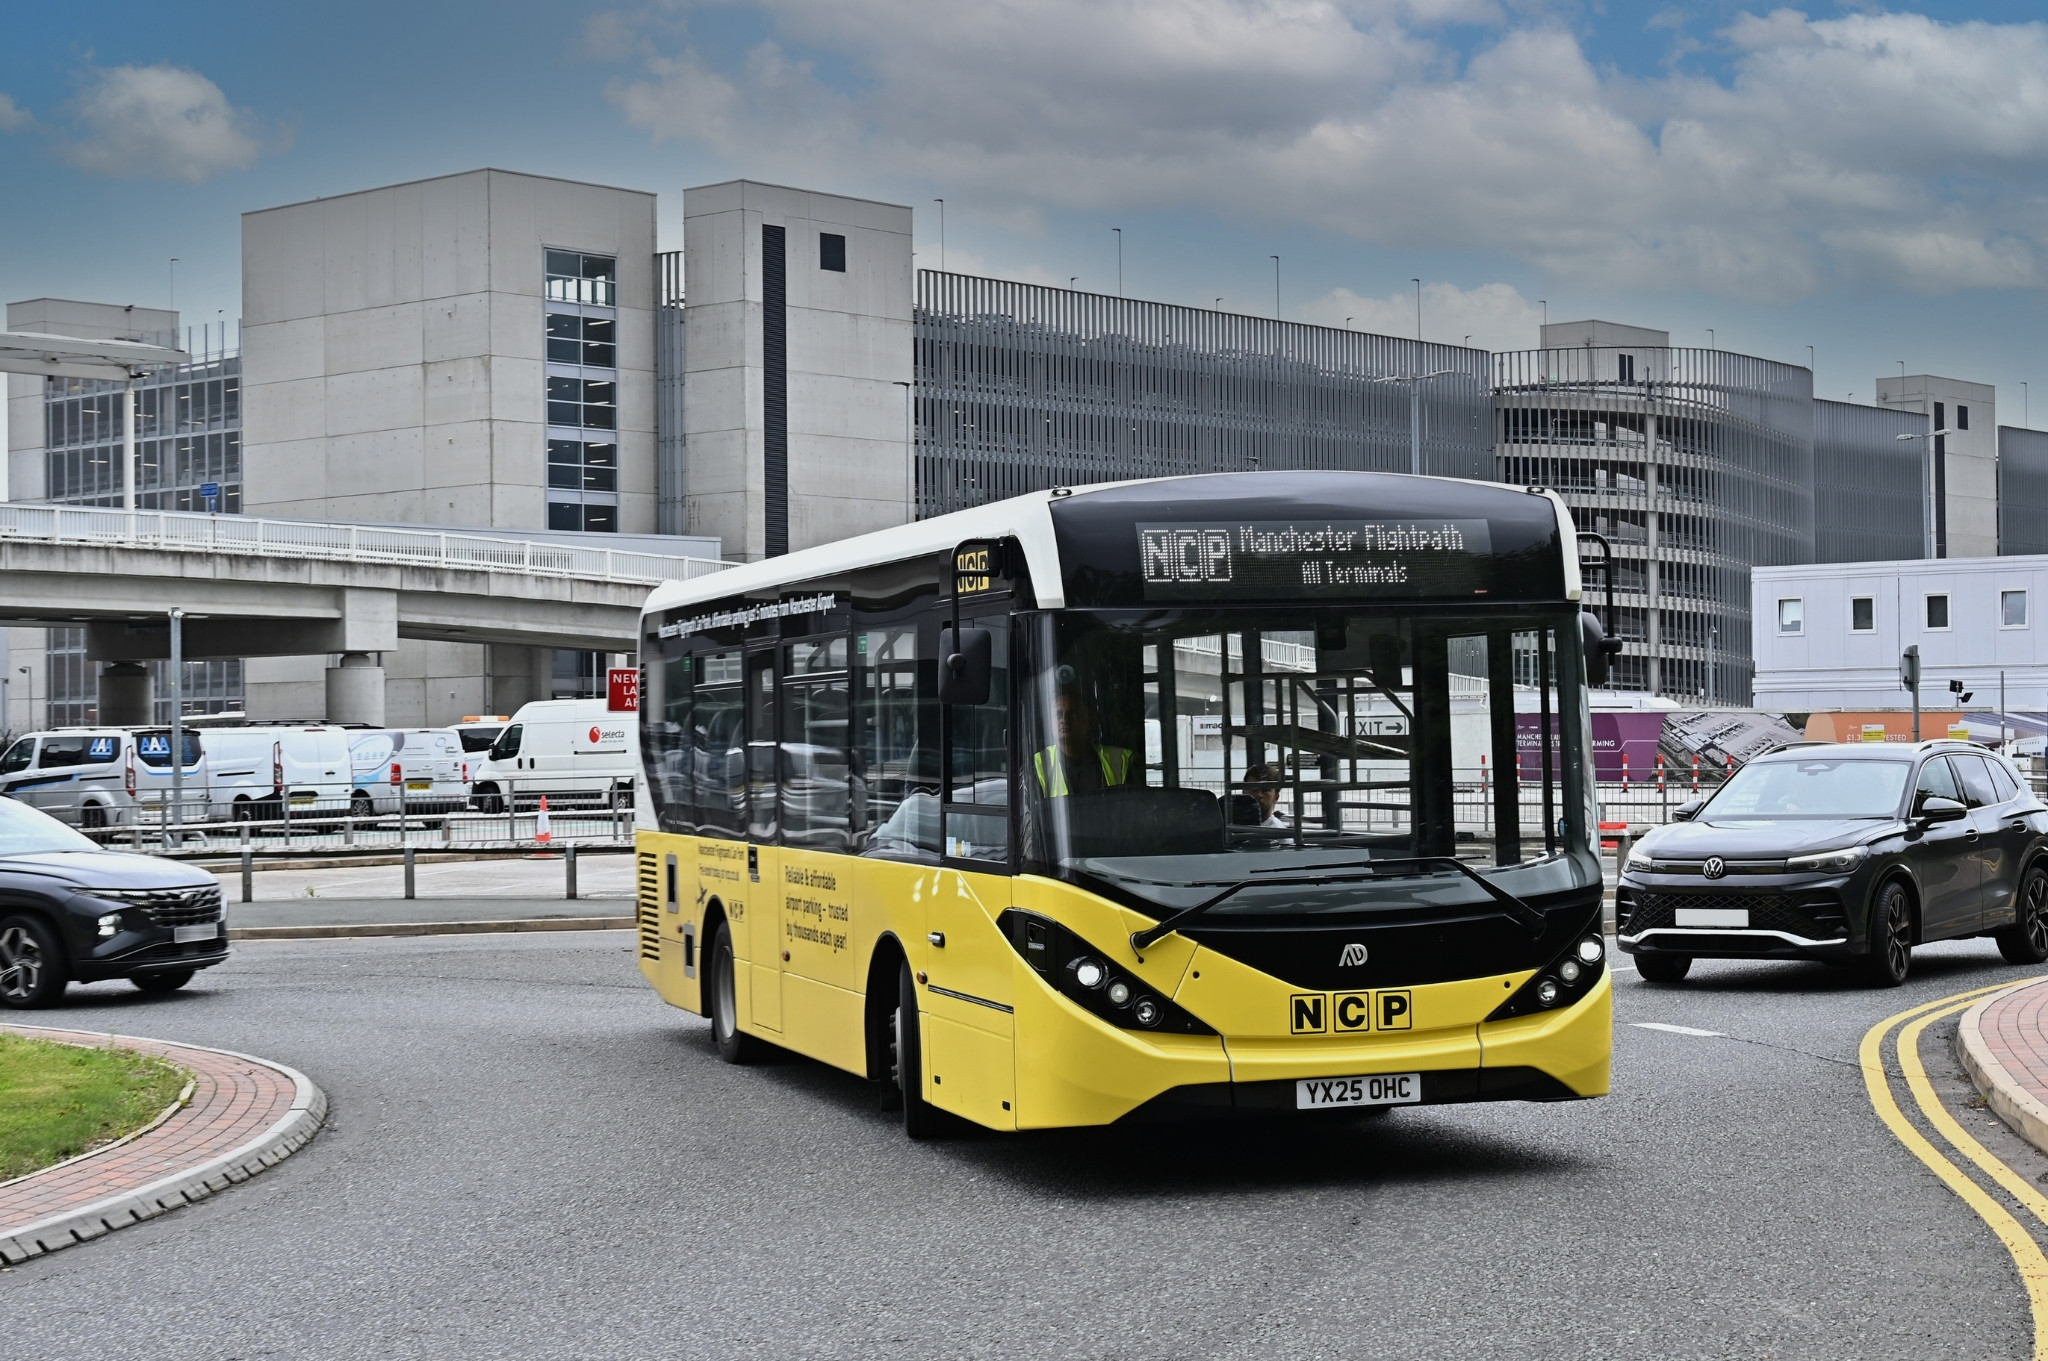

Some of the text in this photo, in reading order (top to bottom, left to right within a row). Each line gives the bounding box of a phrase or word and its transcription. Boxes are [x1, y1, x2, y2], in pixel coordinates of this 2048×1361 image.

[1239, 523, 1464, 552] Manchester Flightpath
[1144, 532, 1230, 580] NCP
[1301, 560, 1408, 584] All Terminals
[1355, 721, 1383, 735] XIT
[785, 865, 836, 891] Reliable & affordable
[786, 892, 802, 917] airport
[803, 896, 822, 923] parking
[793, 920, 819, 944] thousands
[1293, 994, 1409, 1031] NCP
[1306, 1076, 1411, 1104] YX25 OHC
